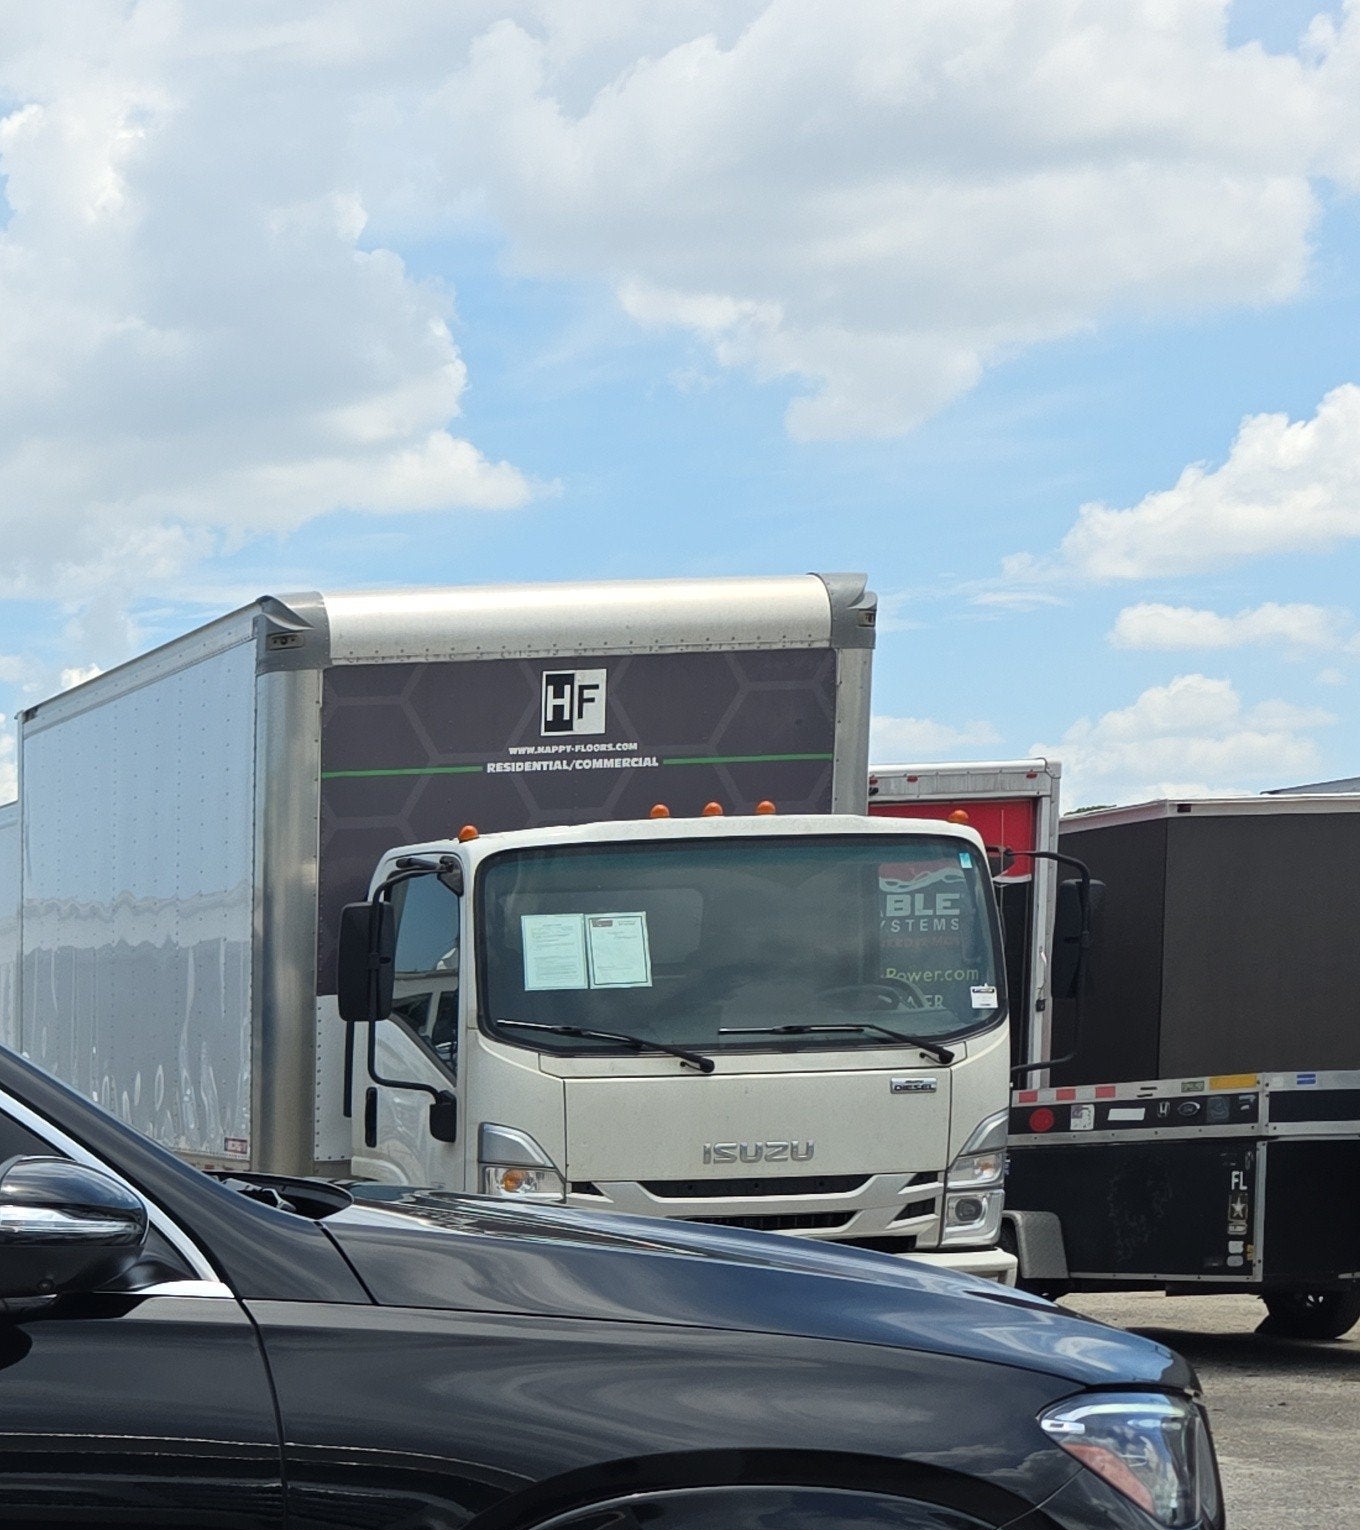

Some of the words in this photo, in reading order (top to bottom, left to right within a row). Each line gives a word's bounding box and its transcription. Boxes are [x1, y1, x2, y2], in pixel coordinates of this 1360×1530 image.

[546, 684, 599, 721] HF
[508, 742, 638, 756] WWW.HAPPY-FLOORS.COM
[487, 757, 659, 774] RESIDENTIAL/COMMERCIAL
[880, 893, 960, 916] BLE
[703, 1140, 815, 1164] ISUZU
